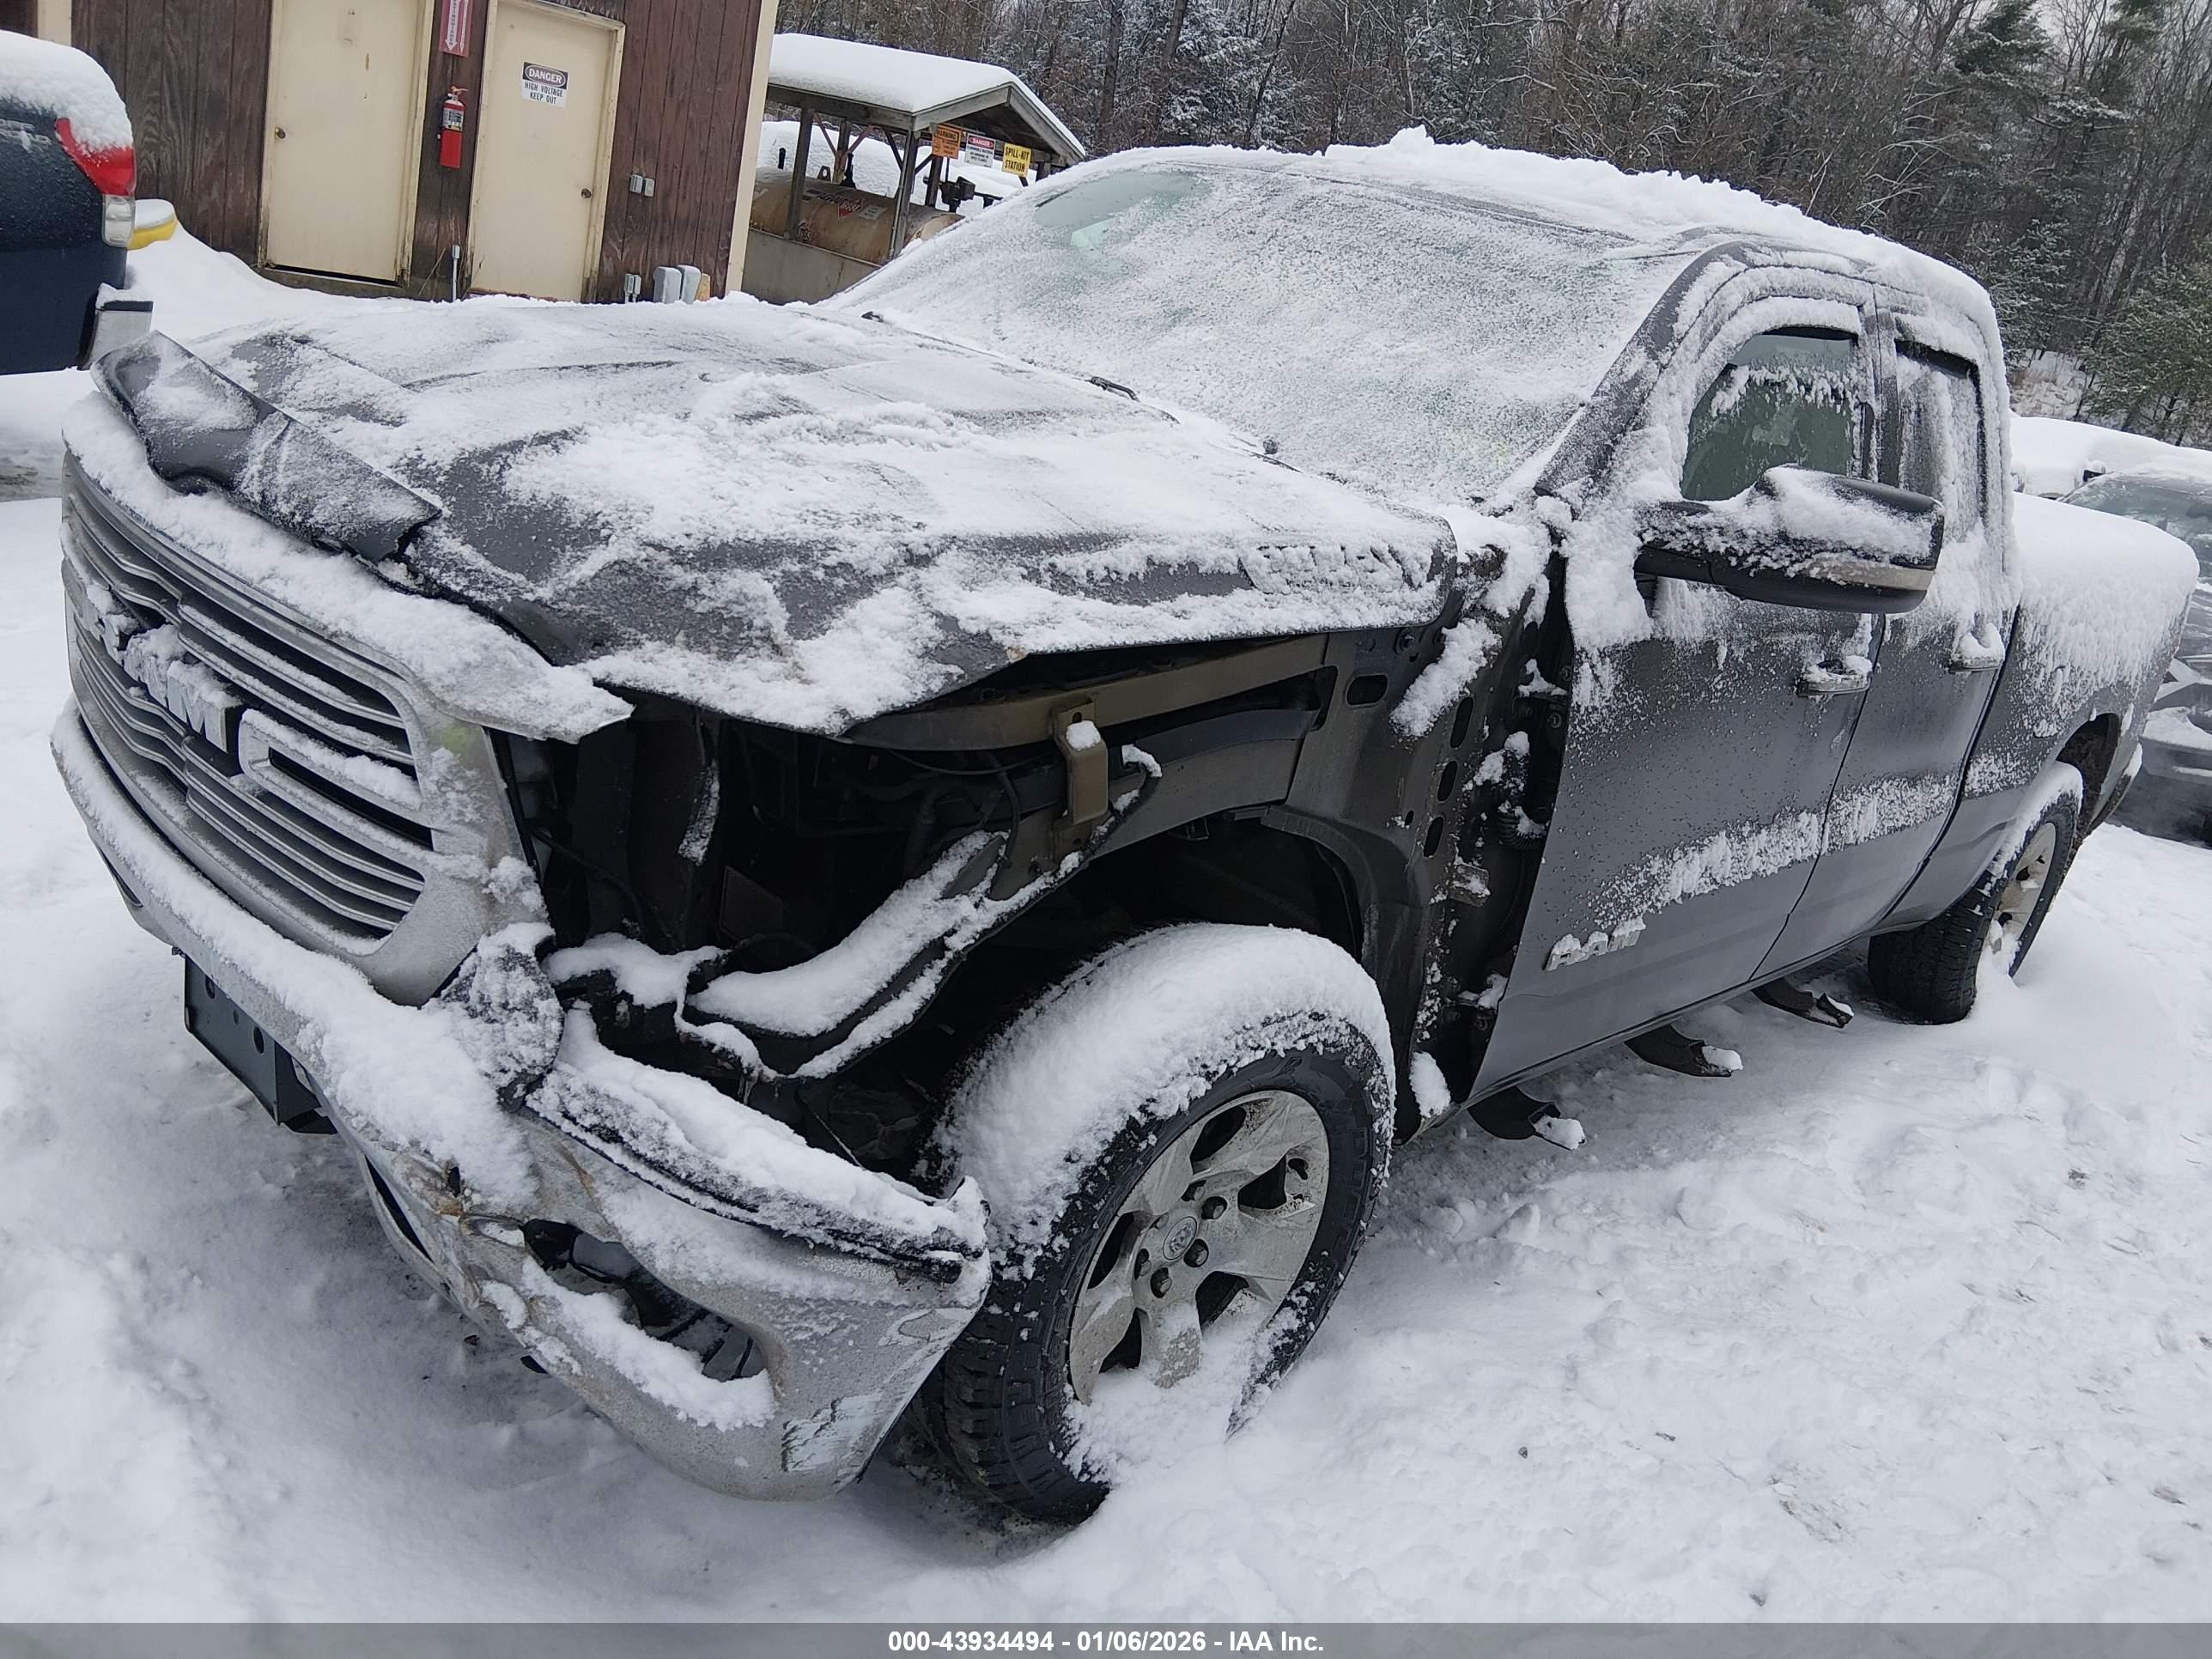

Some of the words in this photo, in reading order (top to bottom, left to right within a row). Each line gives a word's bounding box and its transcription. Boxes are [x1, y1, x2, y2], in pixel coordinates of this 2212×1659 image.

[528, 68, 562, 84] DANGER
[524, 81, 538, 92] HIGH
[541, 85, 563, 98] VOLTAGE
[529, 90, 544, 101] KEEP
[545, 94, 556, 104] OUT
[1005, 146, 1030, 161] SPILL-KIT
[1004, 159, 1026, 173] STATION
